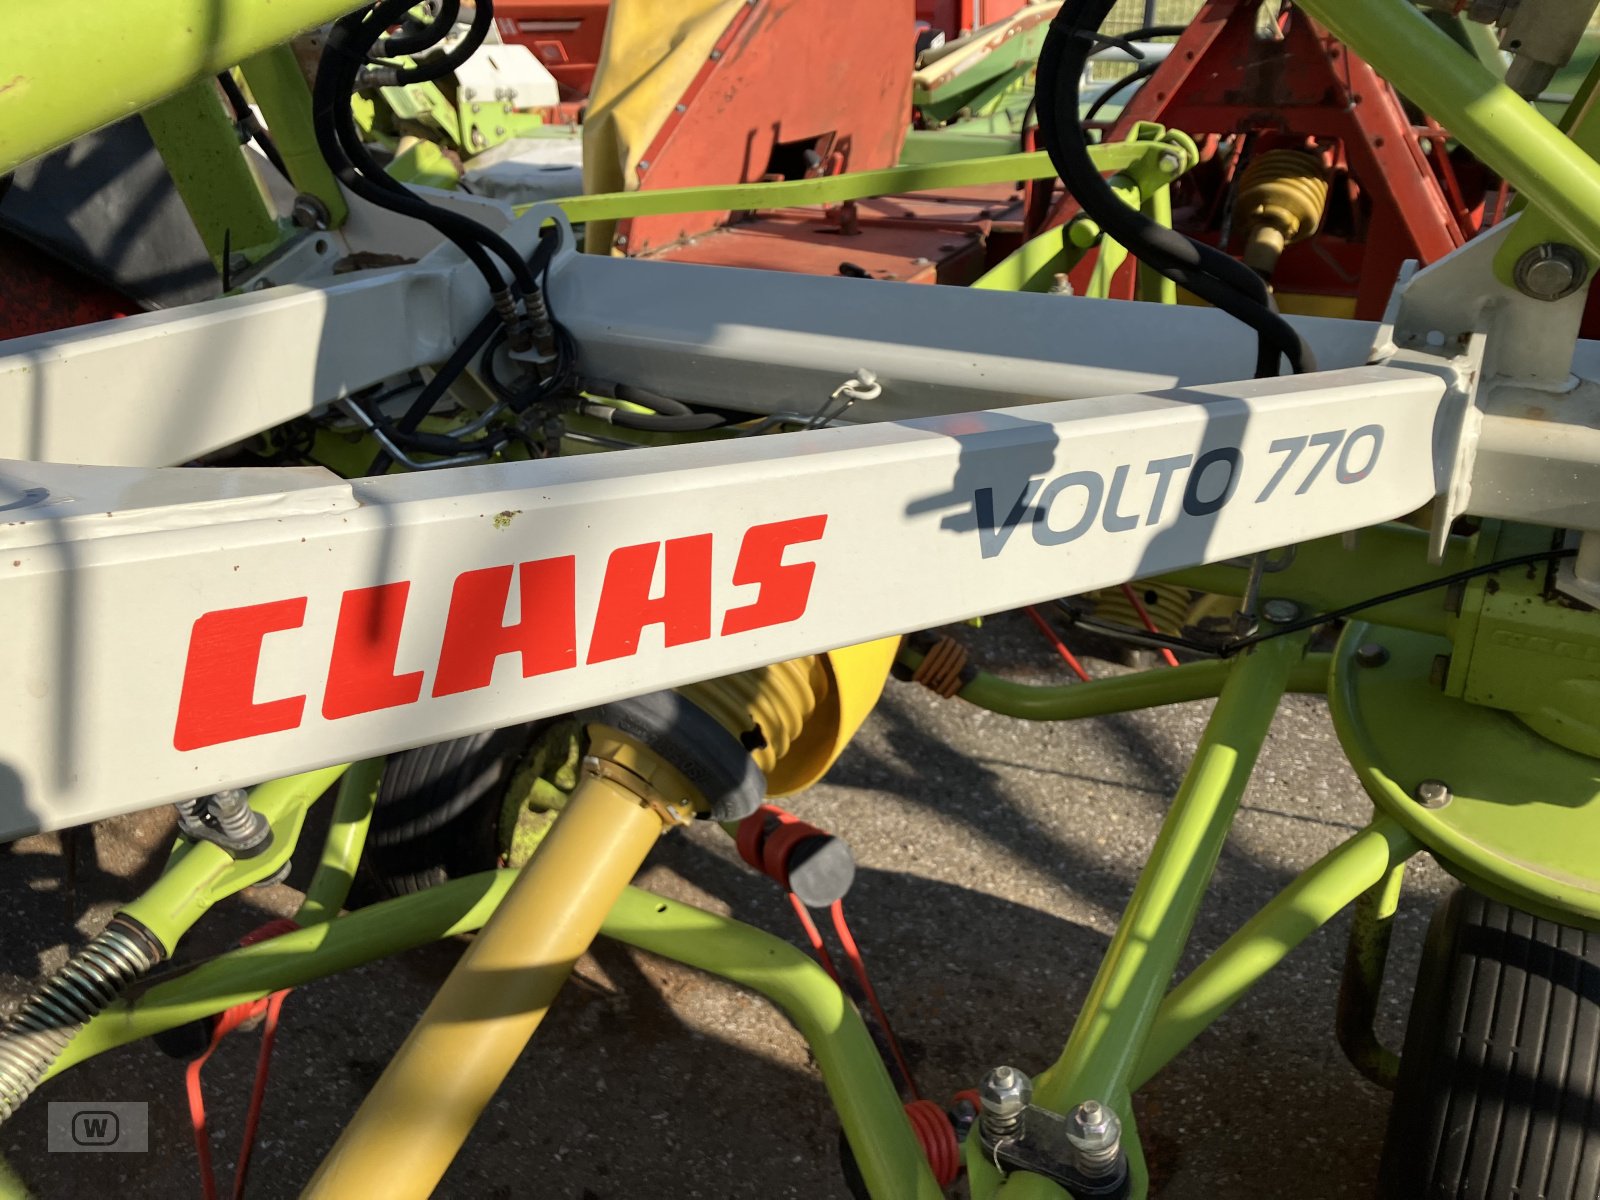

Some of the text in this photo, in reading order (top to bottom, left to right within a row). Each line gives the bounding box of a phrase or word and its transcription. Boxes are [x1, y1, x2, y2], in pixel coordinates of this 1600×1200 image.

[974, 424, 1385, 559] VOLTO 770
[173, 514, 828, 752] CLAAS
